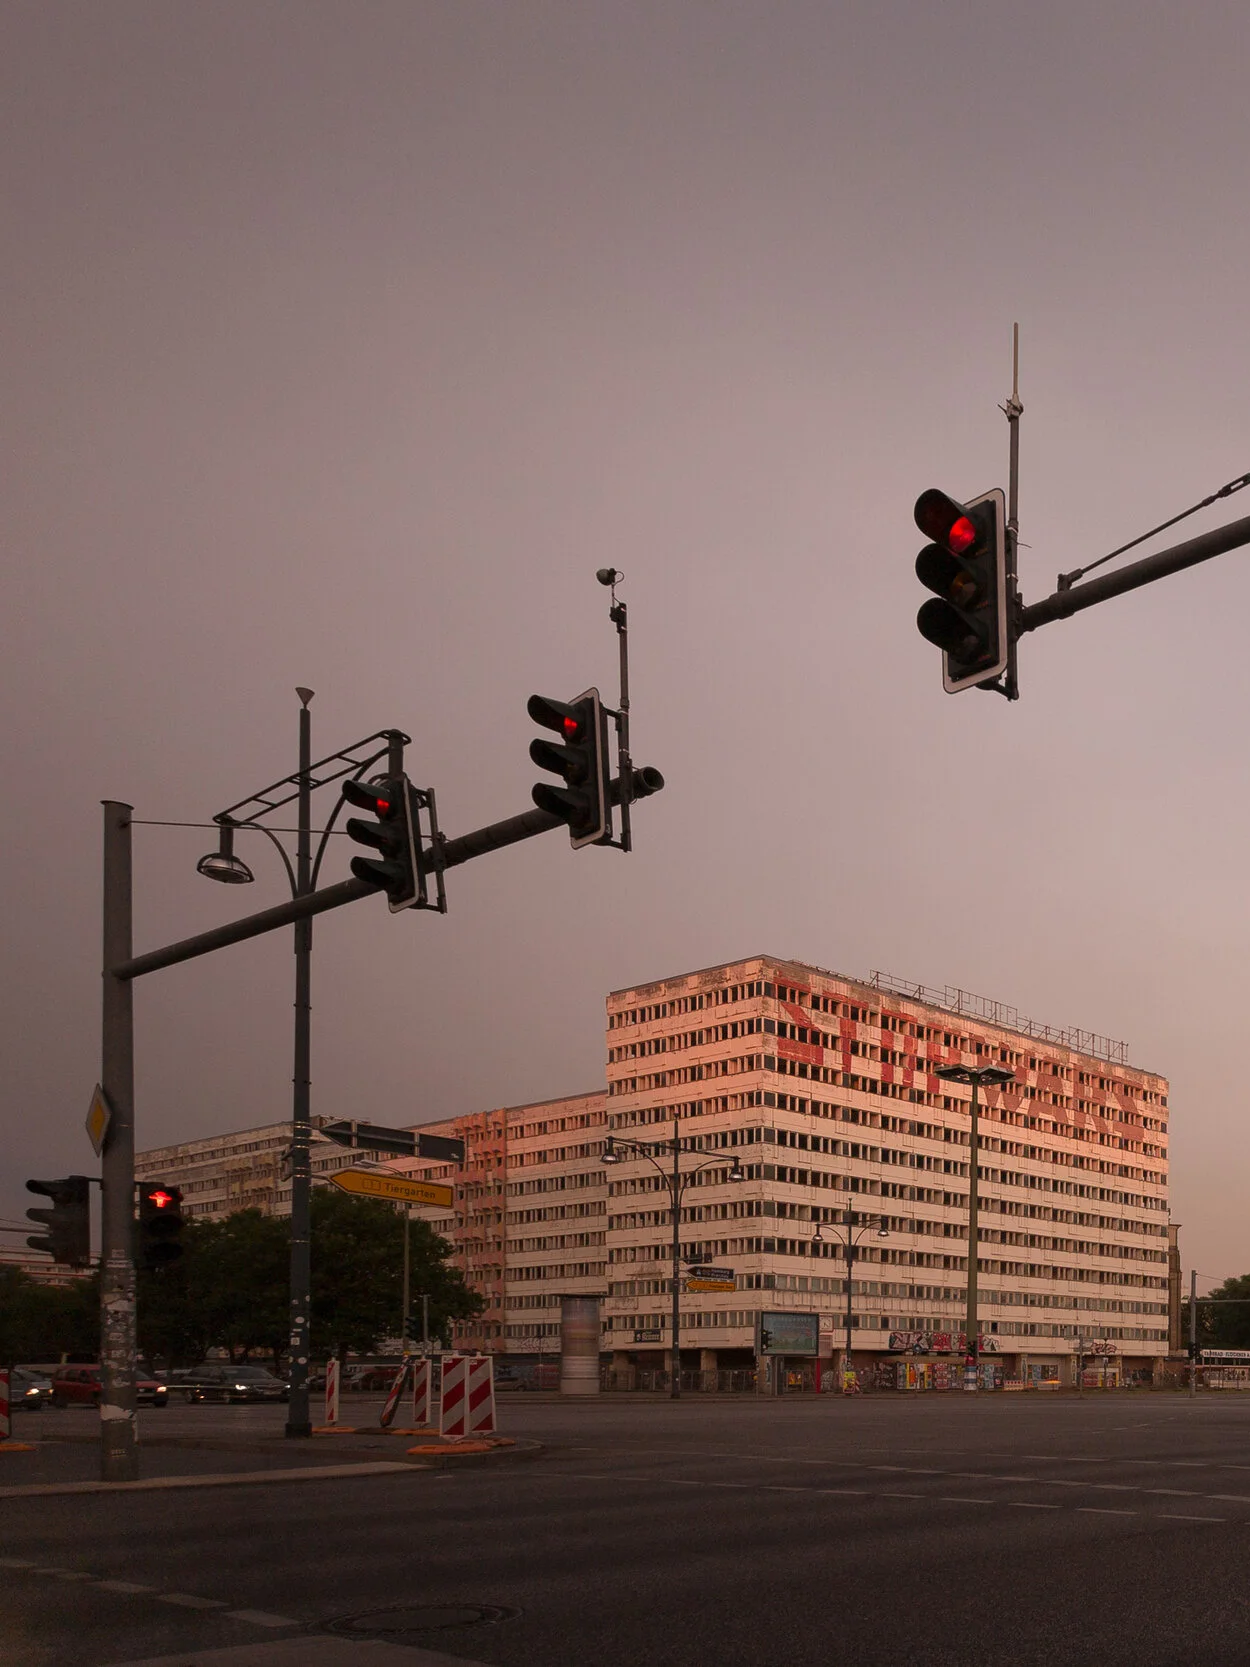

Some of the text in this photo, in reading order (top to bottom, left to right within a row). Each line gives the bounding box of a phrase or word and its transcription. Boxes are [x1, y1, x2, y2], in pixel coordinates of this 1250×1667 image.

[772, 975, 1146, 1142] STOP WARS
[384, 1182, 436, 1199] Tiergarten
